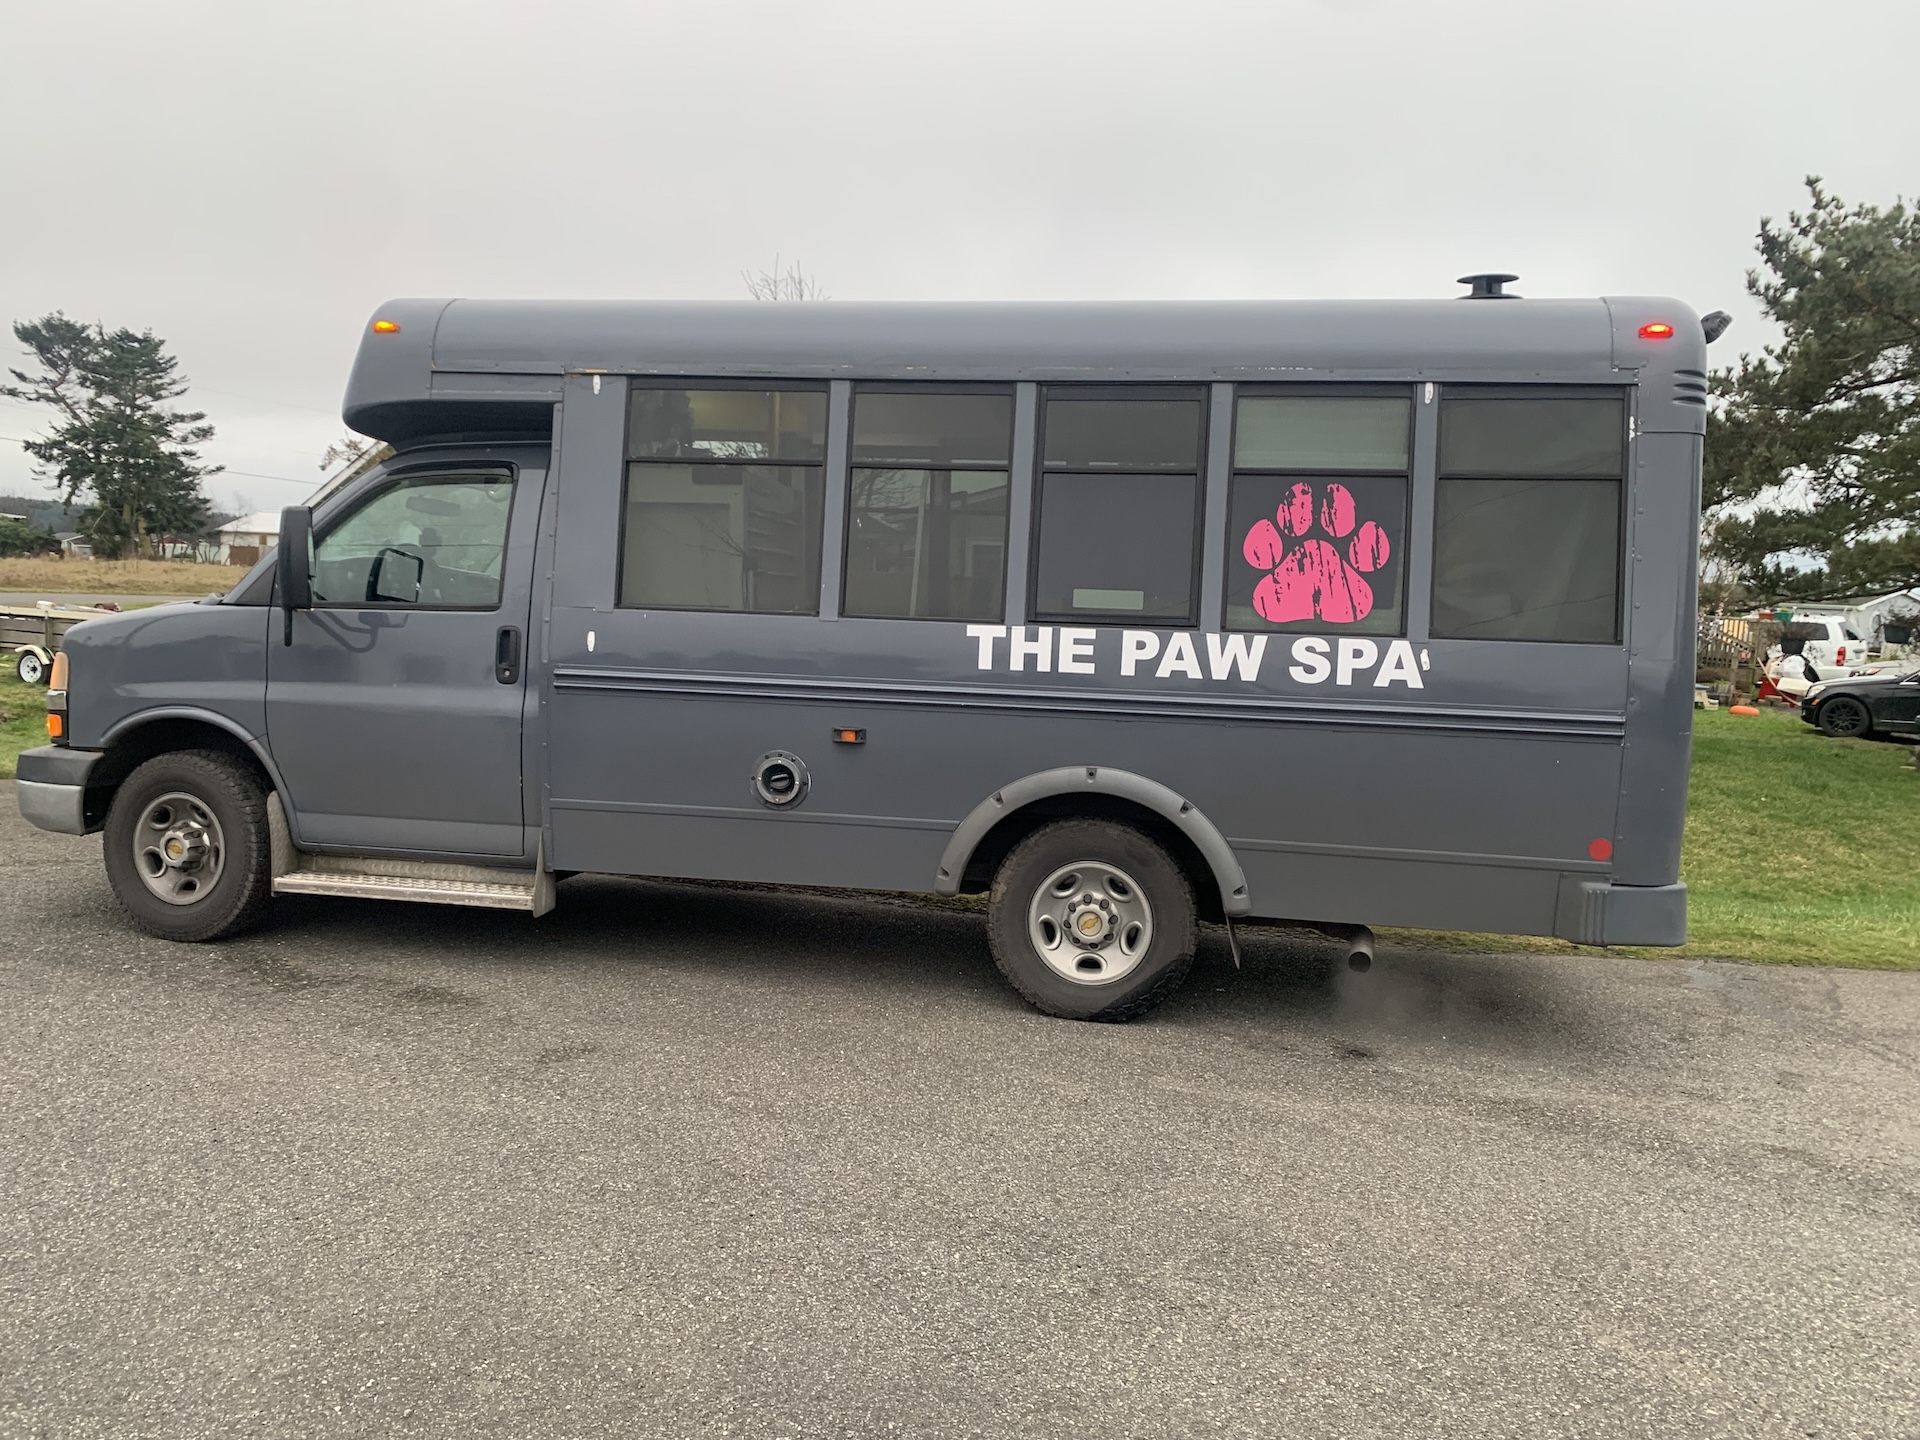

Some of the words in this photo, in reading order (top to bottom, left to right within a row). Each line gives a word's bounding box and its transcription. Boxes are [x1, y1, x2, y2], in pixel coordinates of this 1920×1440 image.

[966, 624, 1097, 675] THE
[1120, 629, 1269, 682] PAW
[1288, 636, 1425, 689] SPA
